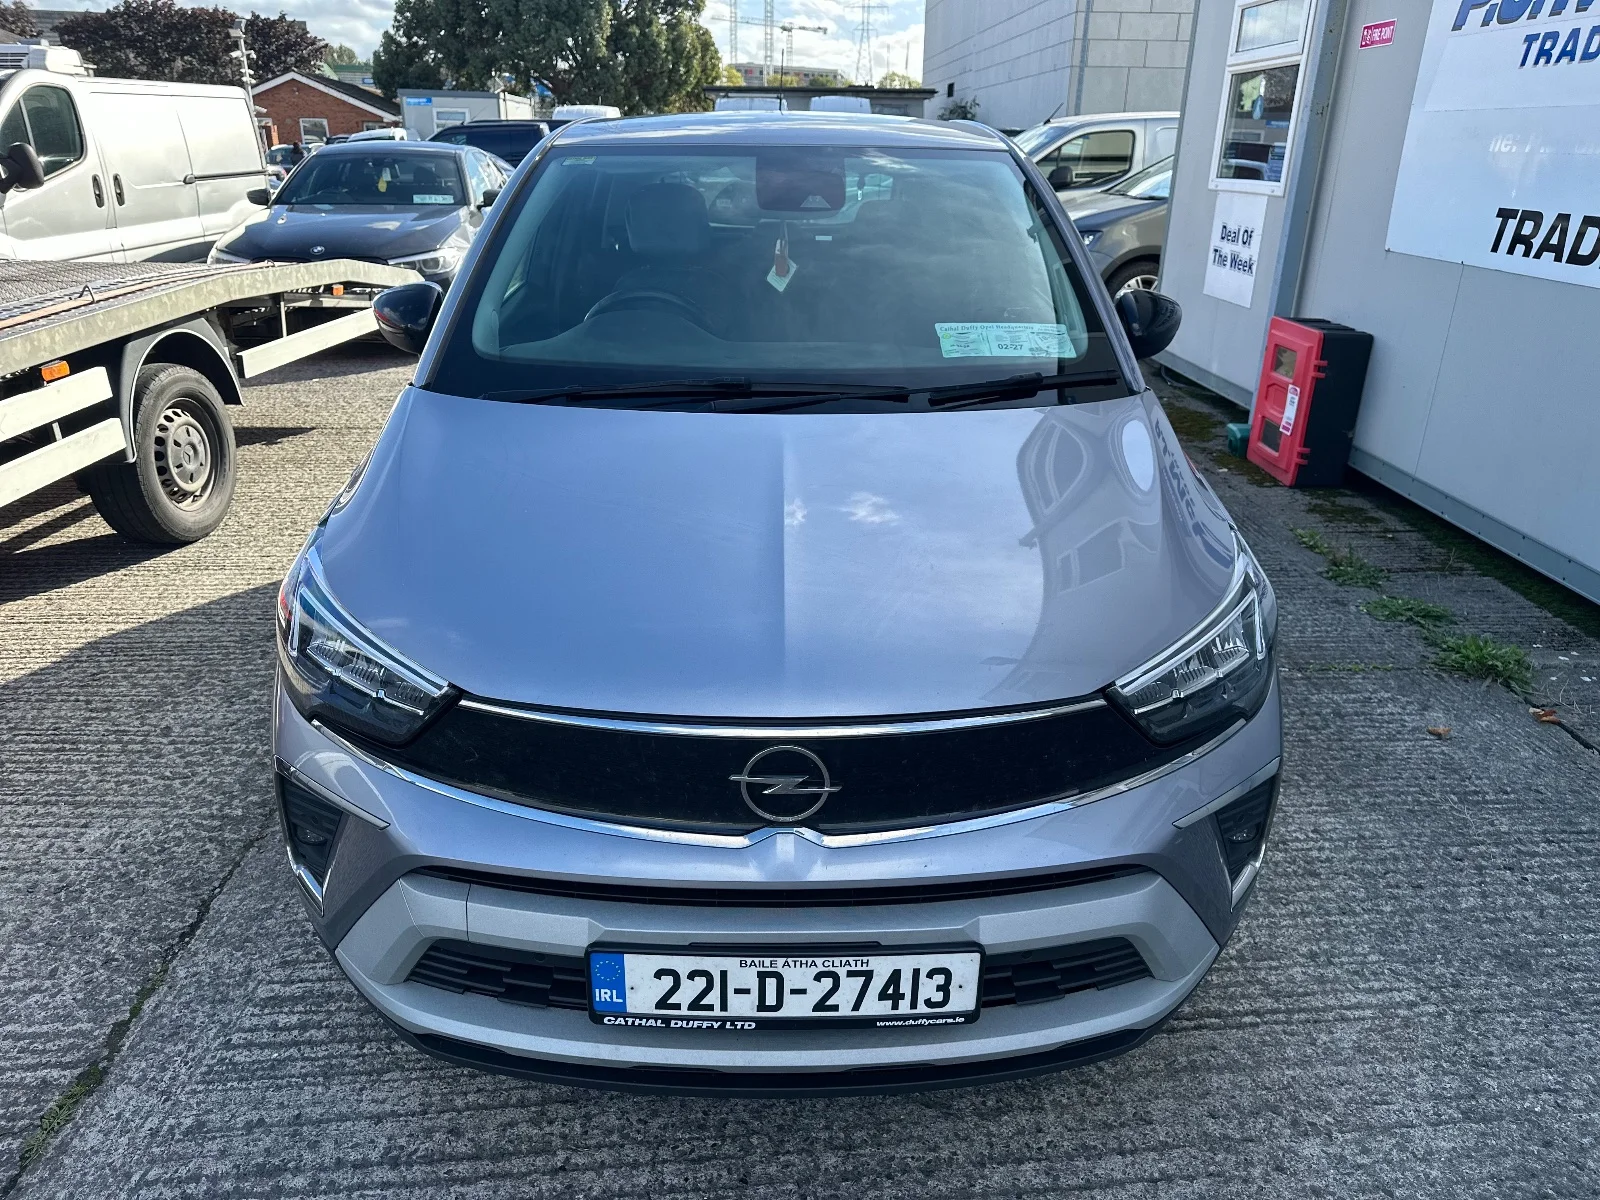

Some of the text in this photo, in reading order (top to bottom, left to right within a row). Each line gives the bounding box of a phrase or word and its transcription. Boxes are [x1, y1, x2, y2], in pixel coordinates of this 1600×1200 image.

[1220, 223, 1254, 247] Deal Of
[1213, 248, 1254, 275] The Week
[997, 343, 1024, 351] 02-27
[739, 957, 870, 969] BAILE ÁTHA CLIATH
[595, 988, 623, 1003] IRL
[653, 967, 953, 1013] 221-D-27413
[603, 1016, 756, 1030] CATHAL DUFFY LTD
[876, 1016, 965, 1027] www.duffycars.ie
